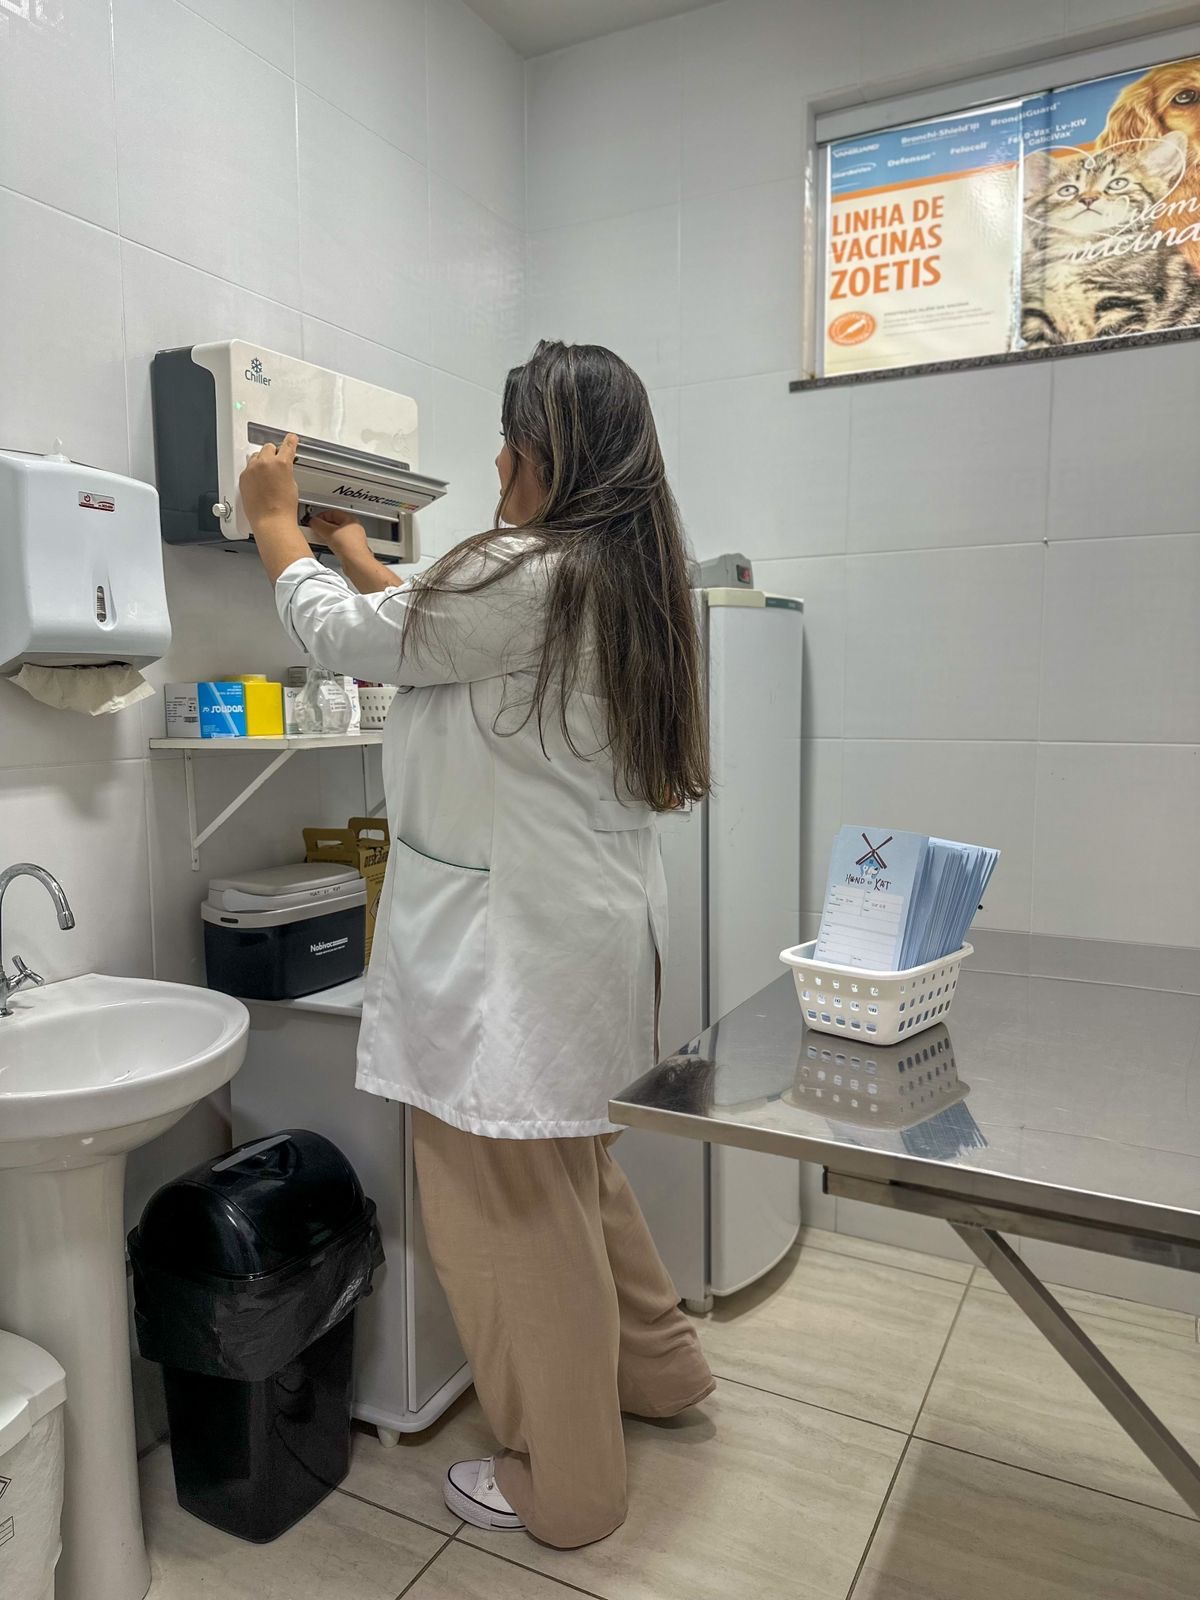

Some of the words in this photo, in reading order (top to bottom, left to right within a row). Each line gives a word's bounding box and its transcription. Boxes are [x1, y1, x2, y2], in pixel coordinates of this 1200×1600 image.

[887, 152, 932, 167] Defensor
[832, 203, 905, 237] LINHA
[912, 195, 945, 223] DE
[831, 223, 943, 264] VACINAS
[830, 255, 942, 300] ZOETIS
[244, 369, 272, 387] Chiller
[332, 485, 384, 504] Nobivac
[310, 941, 334, 953] Nobivac
